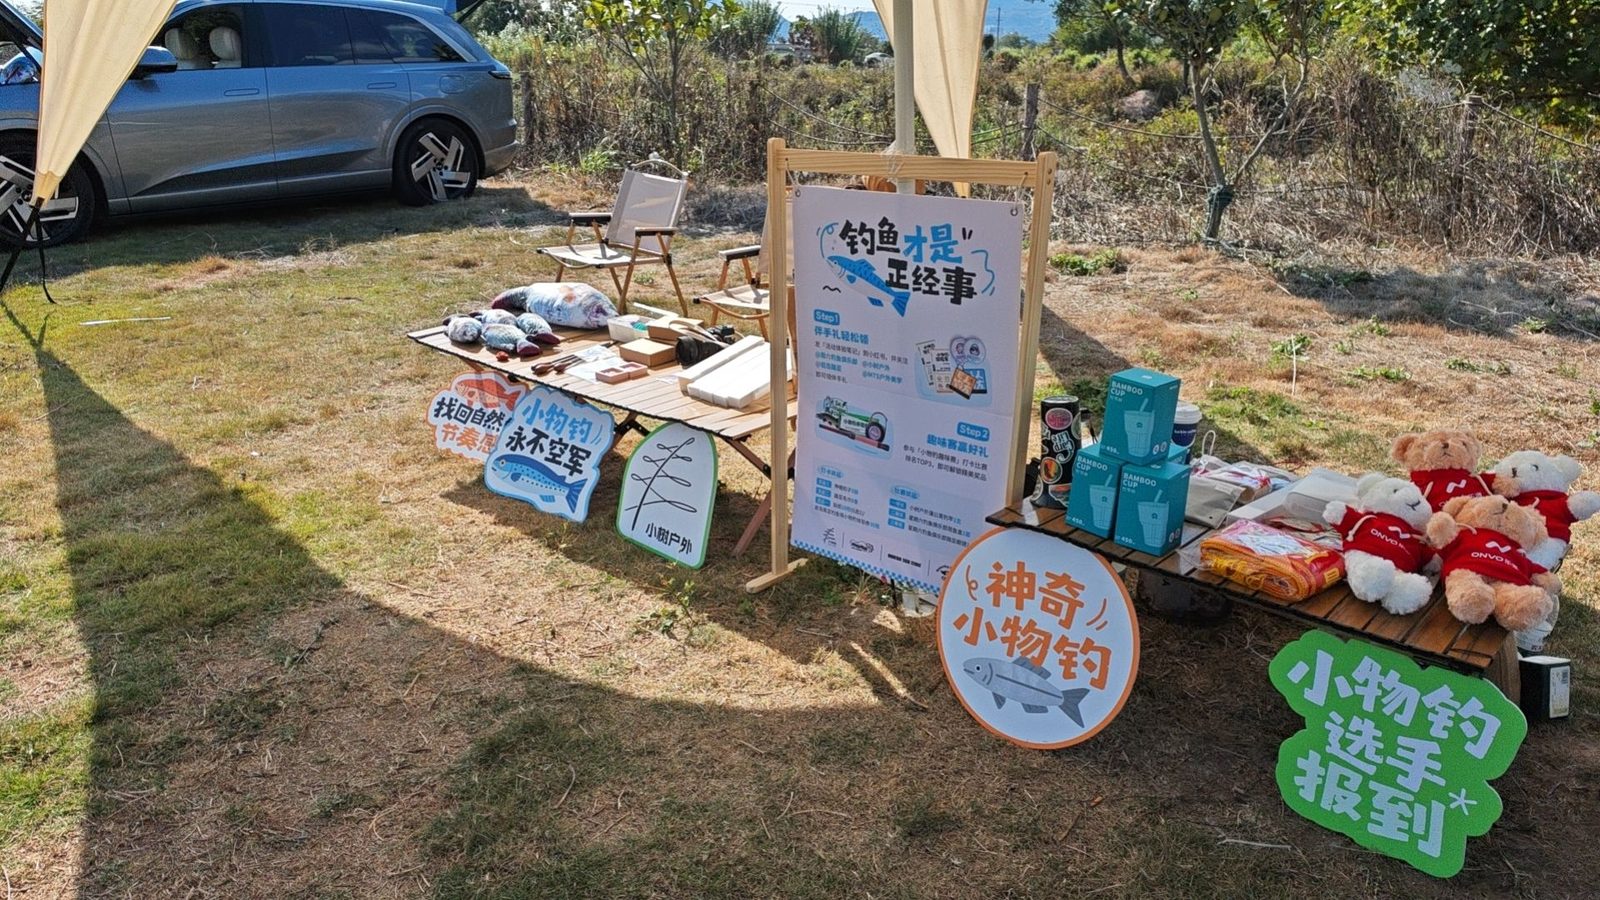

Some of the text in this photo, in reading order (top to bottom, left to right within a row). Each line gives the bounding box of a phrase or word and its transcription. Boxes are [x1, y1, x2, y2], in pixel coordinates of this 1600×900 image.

[839, 216, 962, 264] 钓鱼才是
[886, 258, 977, 305] 正经事
[1110, 388, 1126, 397] CUP
[1111, 381, 1143, 395] BAMBOO
[433, 397, 513, 433] 找回自然
[521, 398, 592, 444] 小物钓
[441, 422, 497, 454] 节奏感
[505, 425, 592, 476] 永不空军
[927, 434, 989, 458] 趣味赛赢好礼
[1076, 463, 1091, 472] CUP
[1077, 456, 1108, 471] BAMBOO
[1123, 473, 1157, 487] BAMBOO
[1122, 480, 1138, 489] CUP
[645, 522, 693, 555] 小树户外
[1370, 528, 1398, 545] ONVO
[1471, 551, 1504, 563] ONVO
[985, 561, 1086, 630] 神奇
[953, 606, 1112, 690] 小物钓
[1287, 649, 1502, 760] 小物钓
[1324, 710, 1446, 793] 选手
[1294, 750, 1446, 858] 报到
